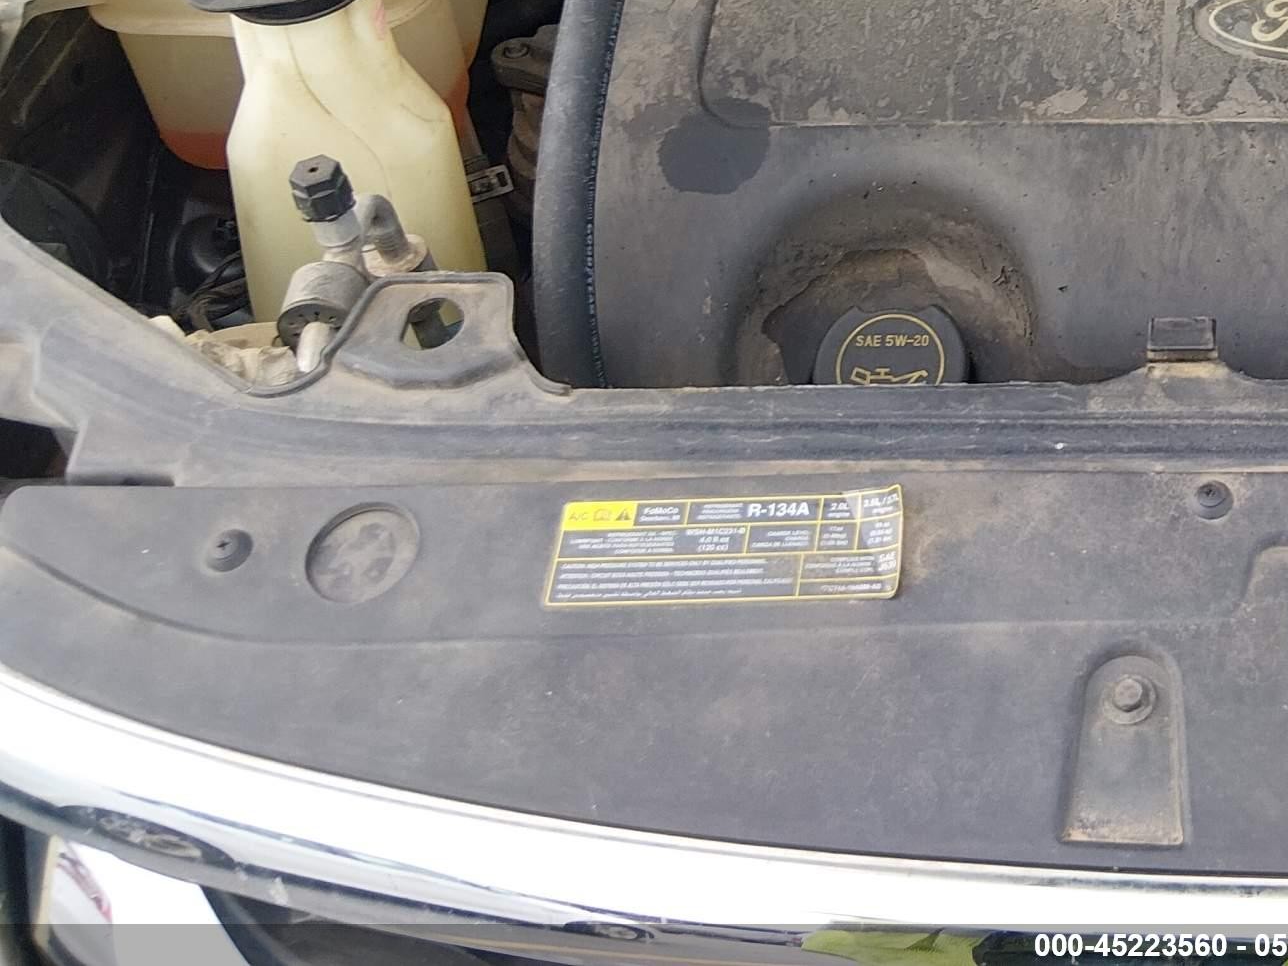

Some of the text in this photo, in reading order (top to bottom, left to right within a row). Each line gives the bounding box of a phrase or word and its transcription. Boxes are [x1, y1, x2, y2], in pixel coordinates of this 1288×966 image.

[856, 335, 930, 347] SAE 5W-20
[747, 500, 810, 518] R-134A
